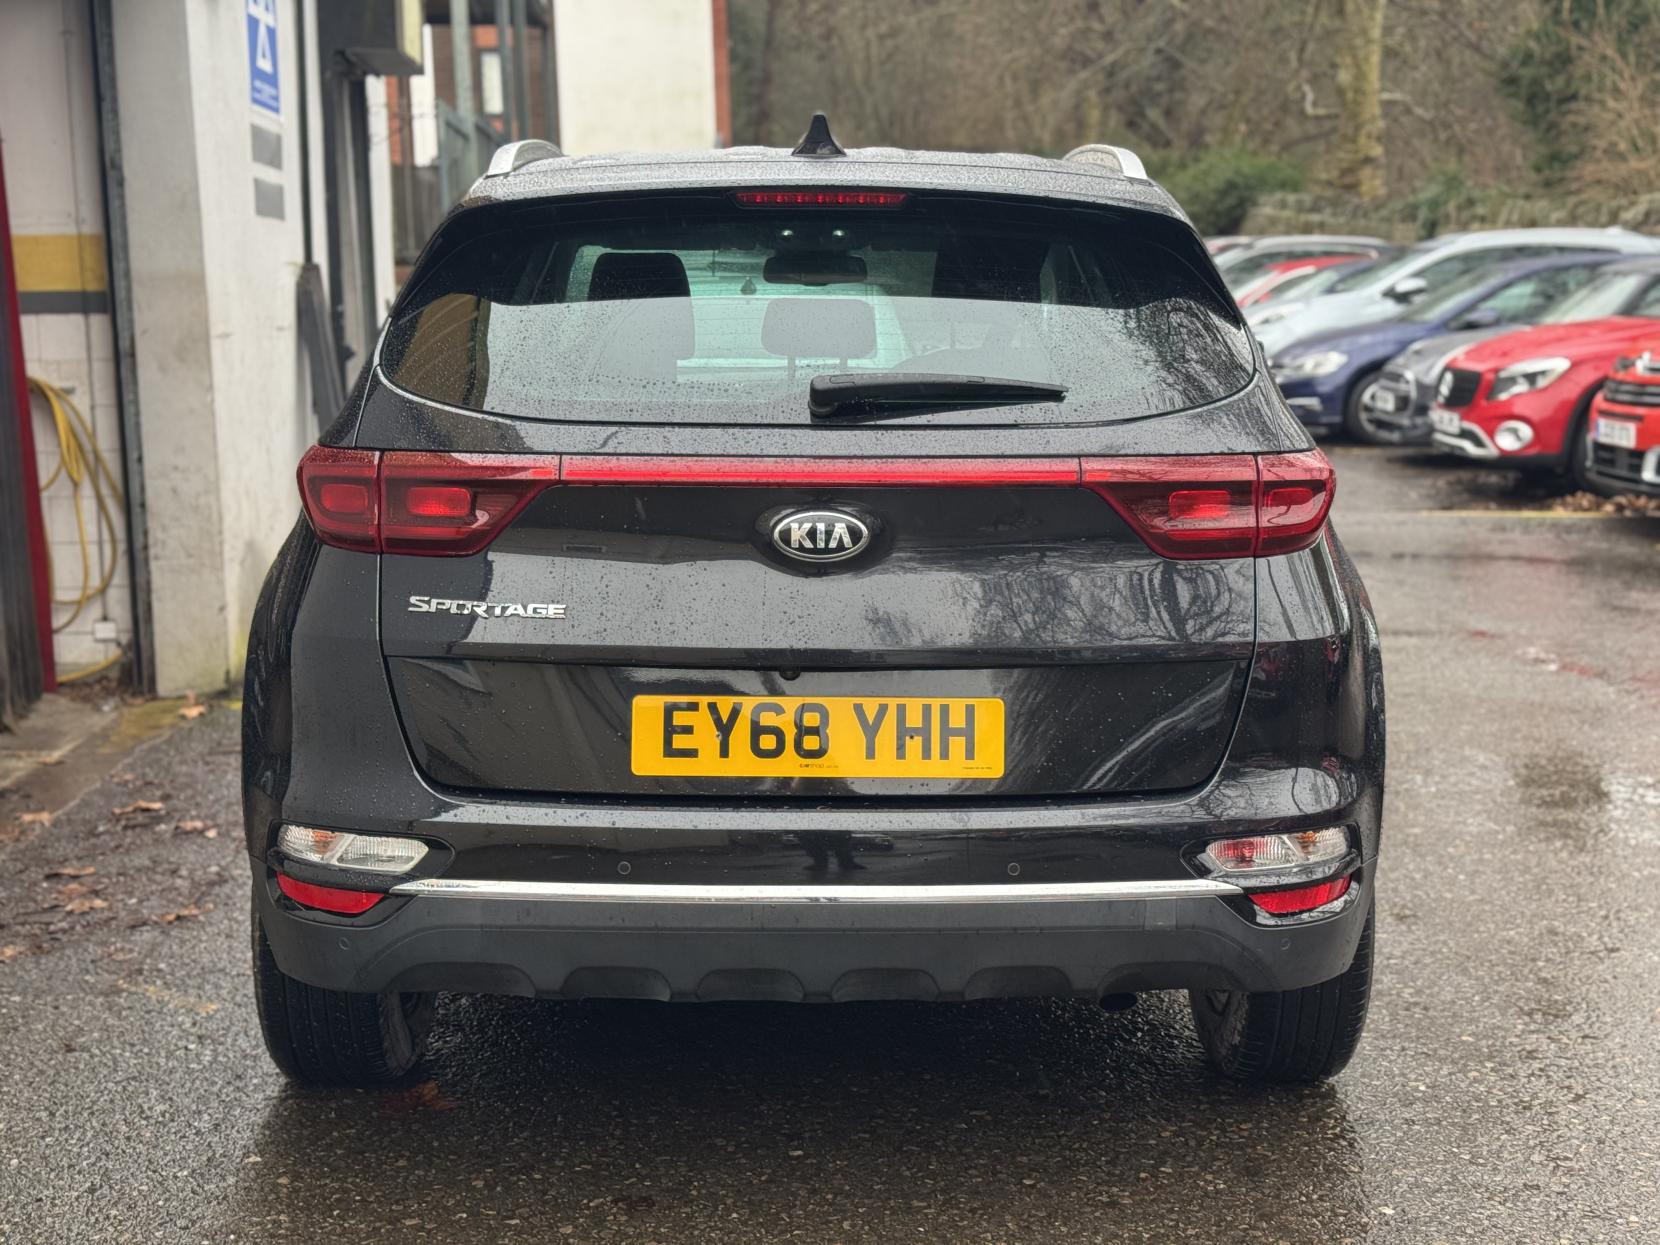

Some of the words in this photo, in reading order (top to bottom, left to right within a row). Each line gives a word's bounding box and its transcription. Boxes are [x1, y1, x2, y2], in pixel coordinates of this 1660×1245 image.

[790, 523, 853, 549] KIA
[407, 595, 567, 619] SPORTAGE
[662, 701, 831, 760] EY68
[852, 702, 976, 762] YHH
